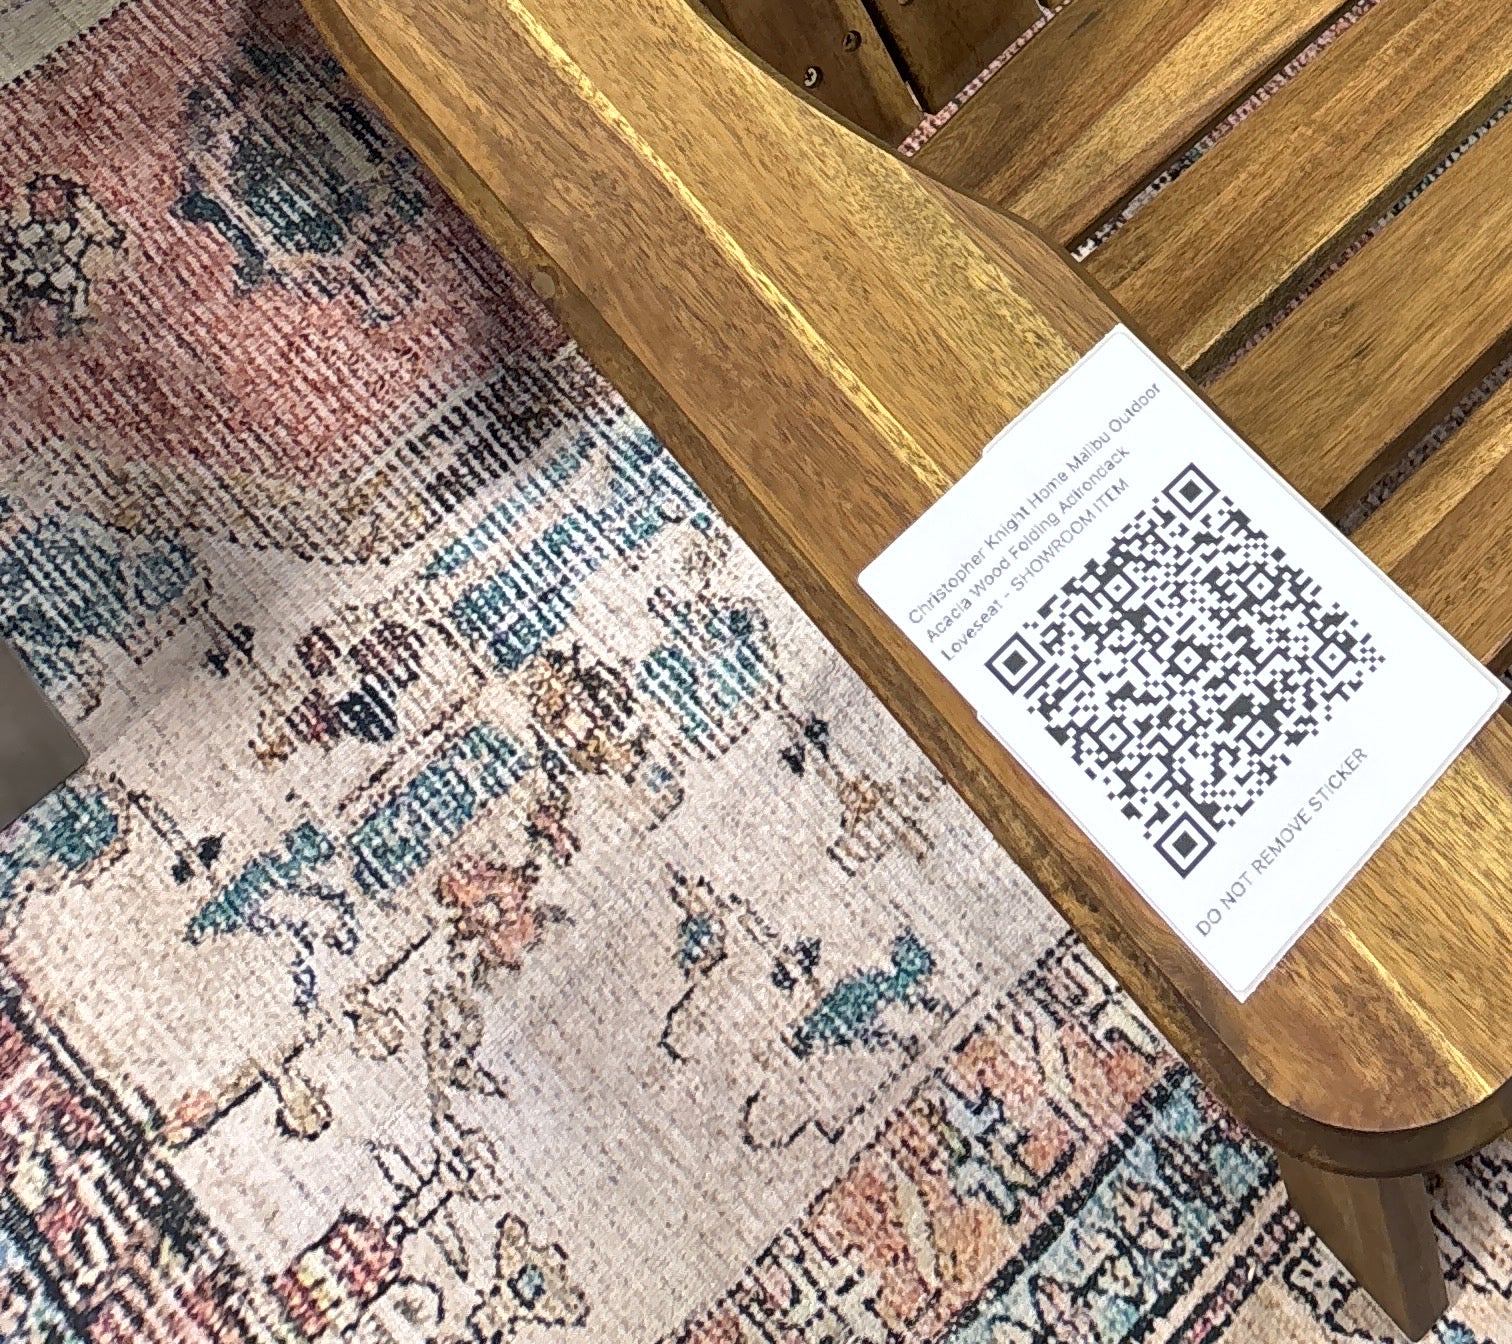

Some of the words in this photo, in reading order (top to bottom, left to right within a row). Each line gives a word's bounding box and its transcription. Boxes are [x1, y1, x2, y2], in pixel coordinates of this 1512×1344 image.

[908, 547, 986, 624] Christopher
[983, 506, 1030, 551] Knight
[1027, 471, 1069, 509] Home
[1065, 431, 1111, 473] Malibu
[1108, 383, 1161, 433] Outdoor
[926, 597, 973, 643] Acacia
[968, 556, 1011, 597] Wood
[1008, 512, 1061, 560] Folding
[1058, 446, 1131, 514] Adirondack
[940, 599, 1004, 661] Loveseat
[1010, 508, 1097, 592] SHOWROOM
[1092, 478, 1130, 513] ITEM
[1195, 908, 1222, 937] DO
[1219, 871, 1253, 910] NOT
[1250, 807, 1313, 875] REMOVE
[1308, 748, 1368, 812] STICKER
